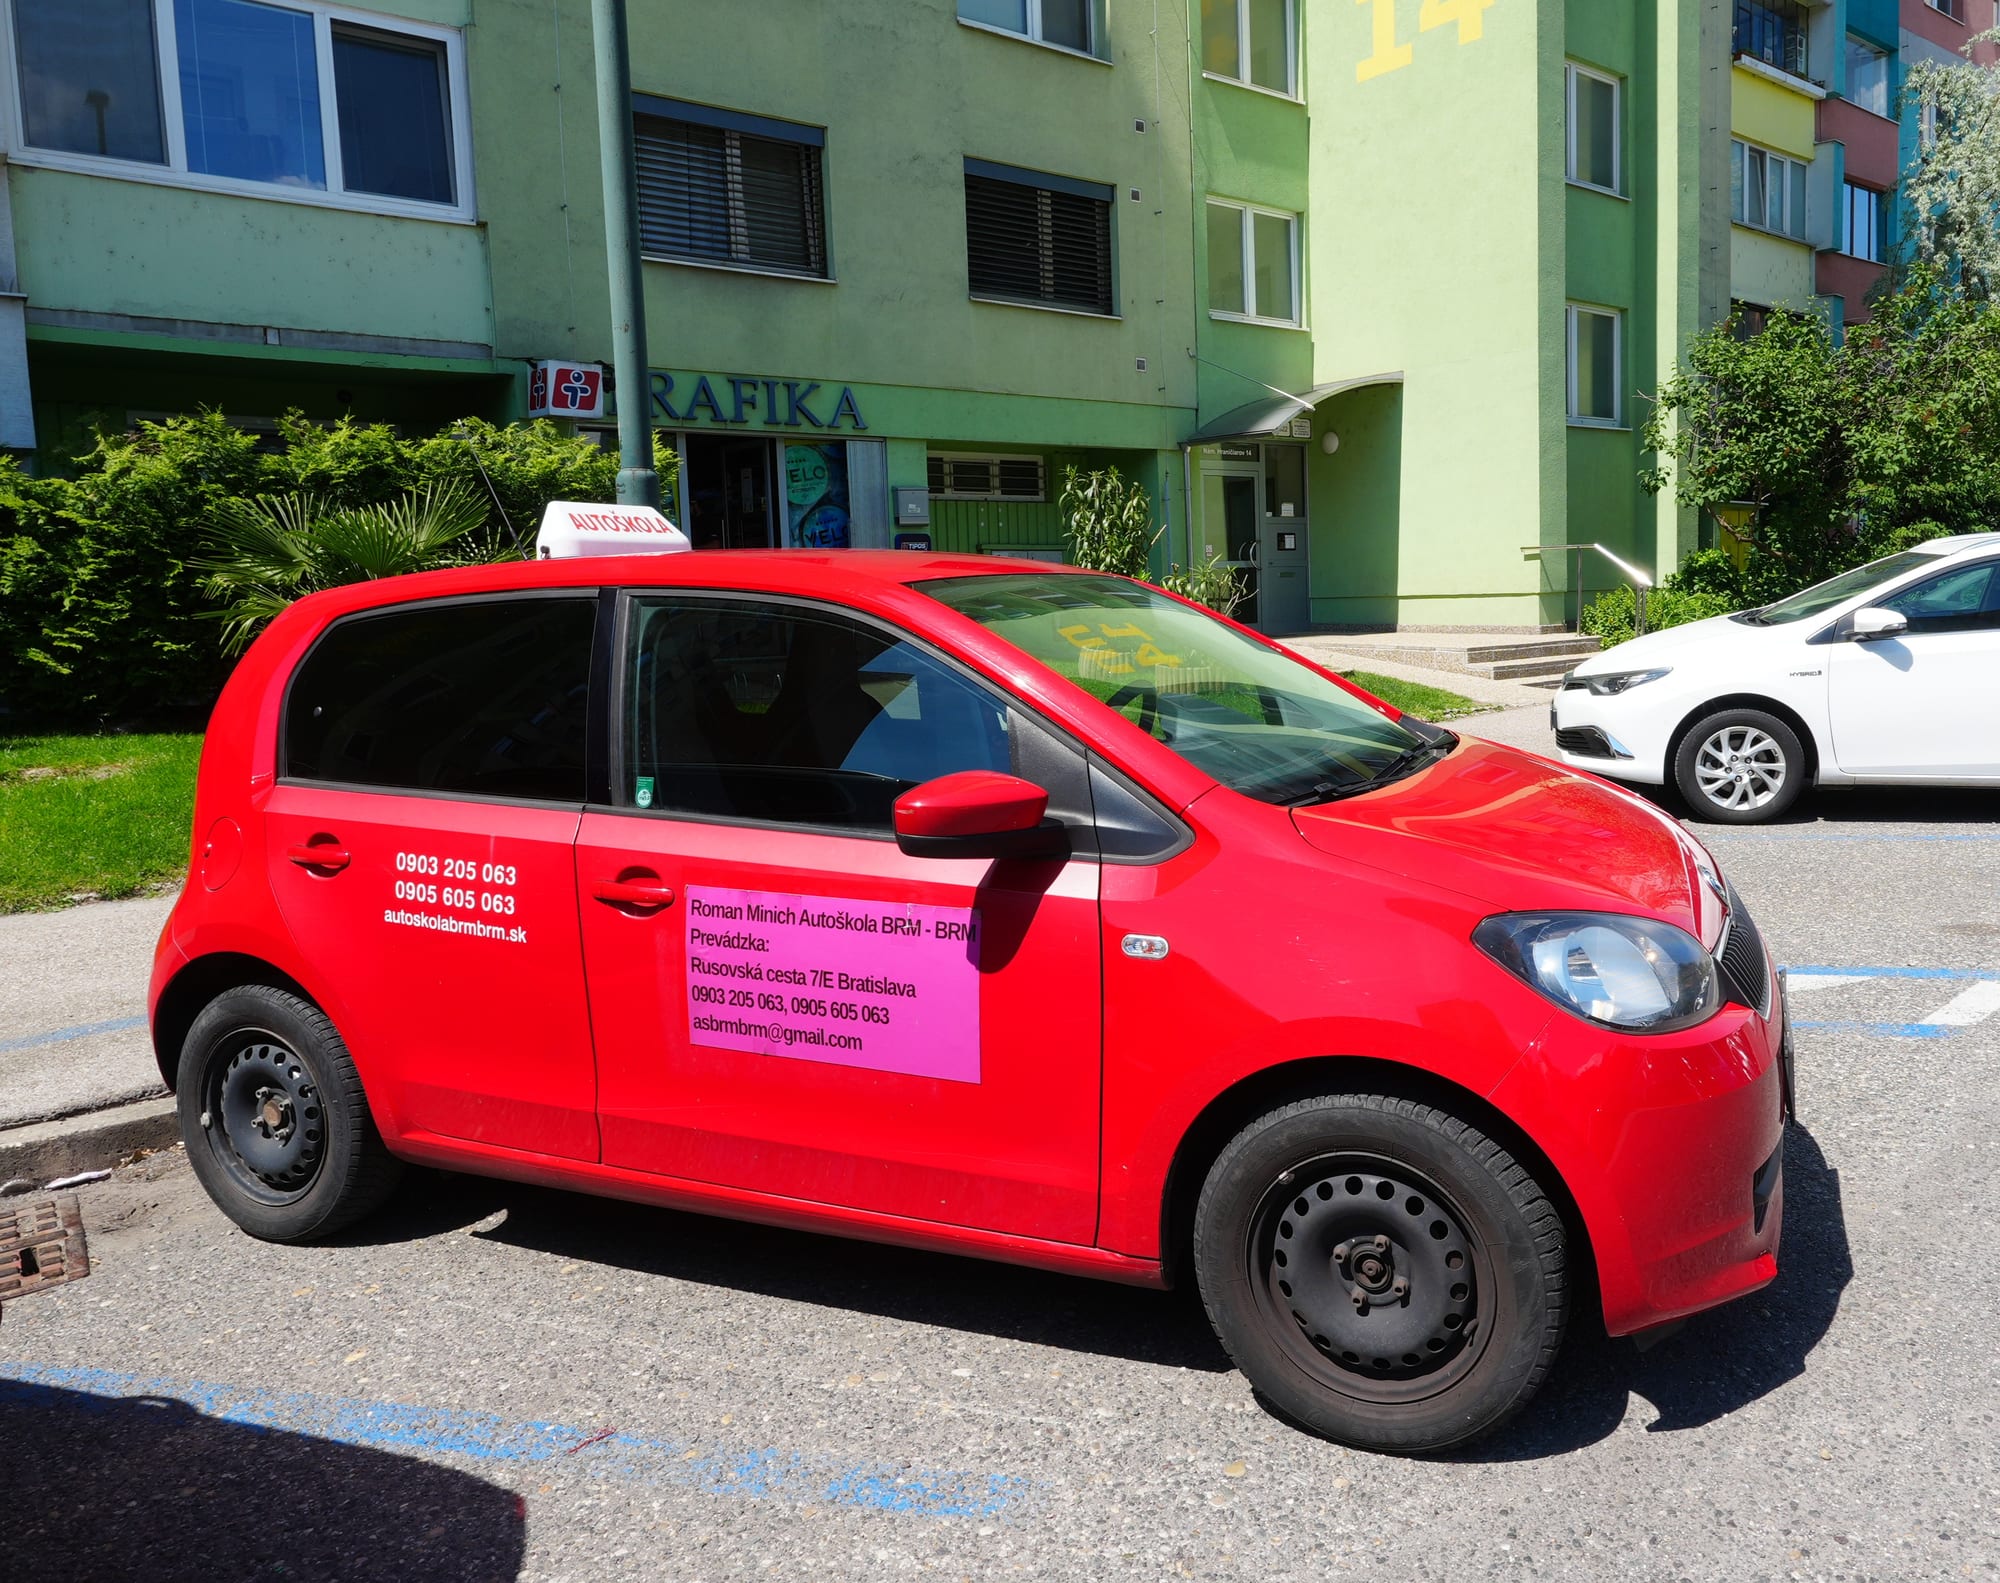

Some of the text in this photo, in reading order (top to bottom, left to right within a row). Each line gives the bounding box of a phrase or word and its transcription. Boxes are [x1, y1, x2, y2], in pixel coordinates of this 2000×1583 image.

[607, 371, 869, 430] RAFIKA
[786, 464, 826, 484] ELO
[568, 509, 674, 534] AUTOŠKOLA
[396, 852, 517, 886] 0903 205 063
[395, 880, 515, 915] 0905 605 063
[384, 909, 527, 944] autoskolabrmbrm.sk
[691, 899, 743, 920] Roman
[746, 903, 796, 925] Minich
[799, 909, 878, 934] Autoškola
[881, 916, 922, 937] BRM
[935, 921, 977, 942] BRM
[690, 928, 770, 952] Prevádzka:
[691, 956, 917, 998] Rusovská cesta 7/E Bratislava
[691, 985, 890, 1025] 0903 205 063, 0905 605 063
[693, 1014, 863, 1050] asbrmbrm@gmail.com
